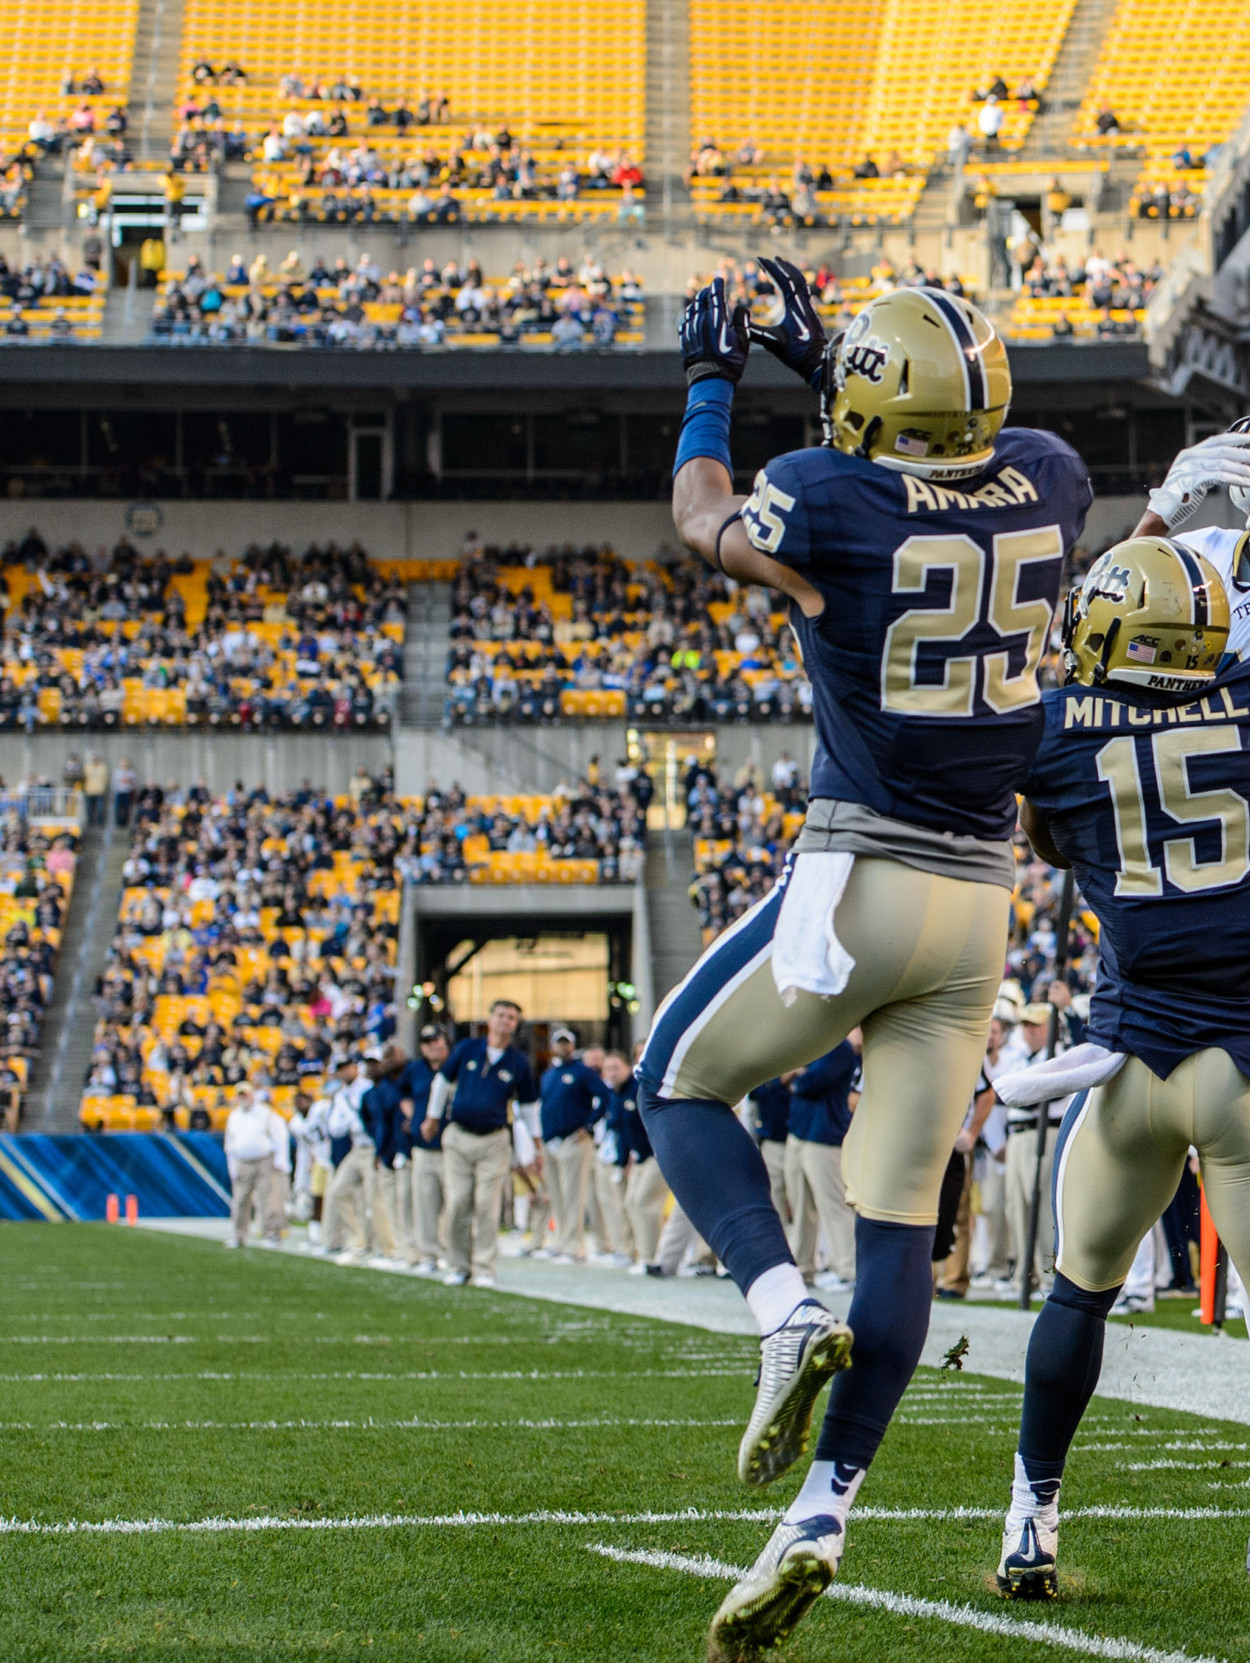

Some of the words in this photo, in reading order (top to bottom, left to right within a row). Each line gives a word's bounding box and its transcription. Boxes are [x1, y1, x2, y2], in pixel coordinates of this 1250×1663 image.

[741, 468, 796, 554] 25
[880, 523, 1064, 717] 25
[1129, 633, 1162, 647] ACC
[1184, 654, 1200, 670] 15
[1063, 686, 1250, 730] MITCHELL
